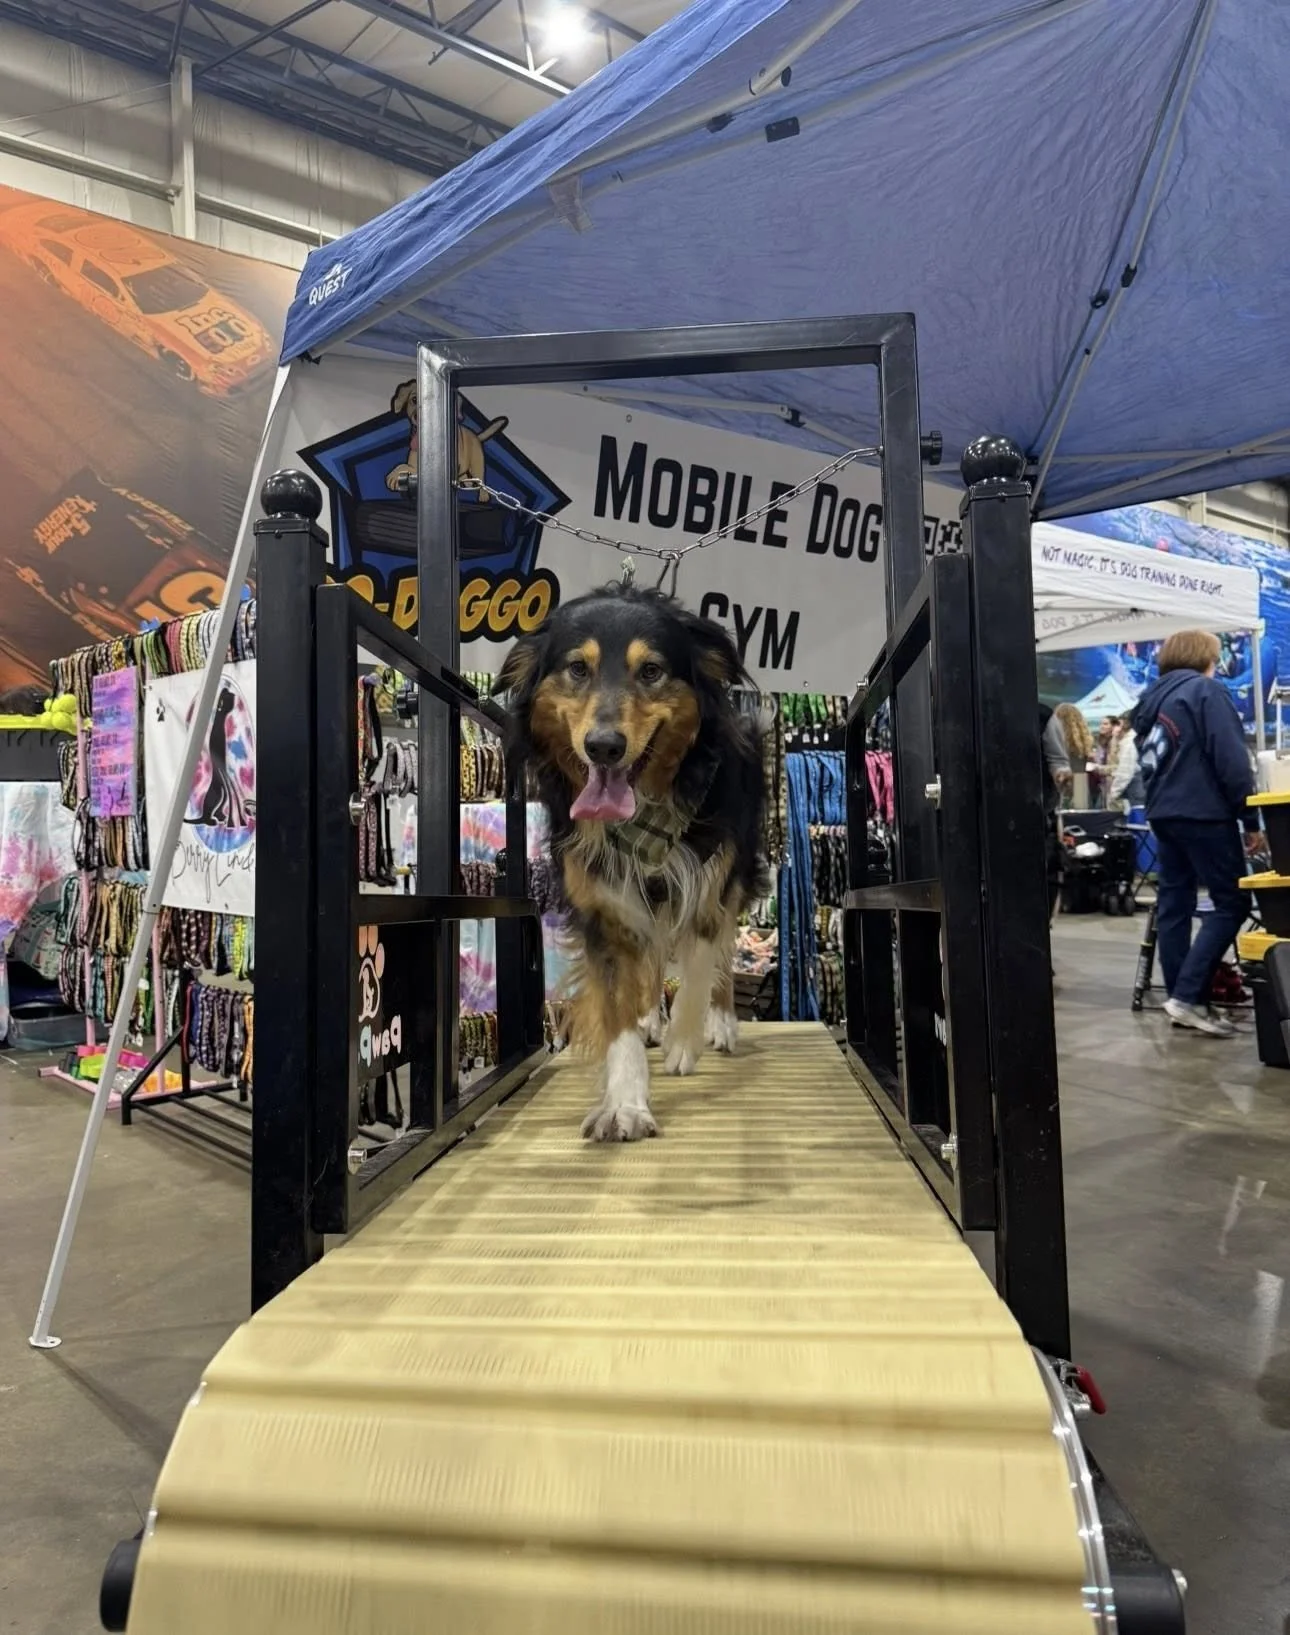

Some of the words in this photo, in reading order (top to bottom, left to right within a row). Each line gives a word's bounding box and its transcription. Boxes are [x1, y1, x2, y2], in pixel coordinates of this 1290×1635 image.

[309, 267, 353, 306] QUEST
[593, 434, 797, 549] MOBILE
[805, 481, 883, 564] DOG
[1041, 545, 1062, 564] NOT
[1120, 561, 1138, 579] DOG
[1140, 566, 1176, 588] TRAINING
[1178, 574, 1199, 592] DONE
